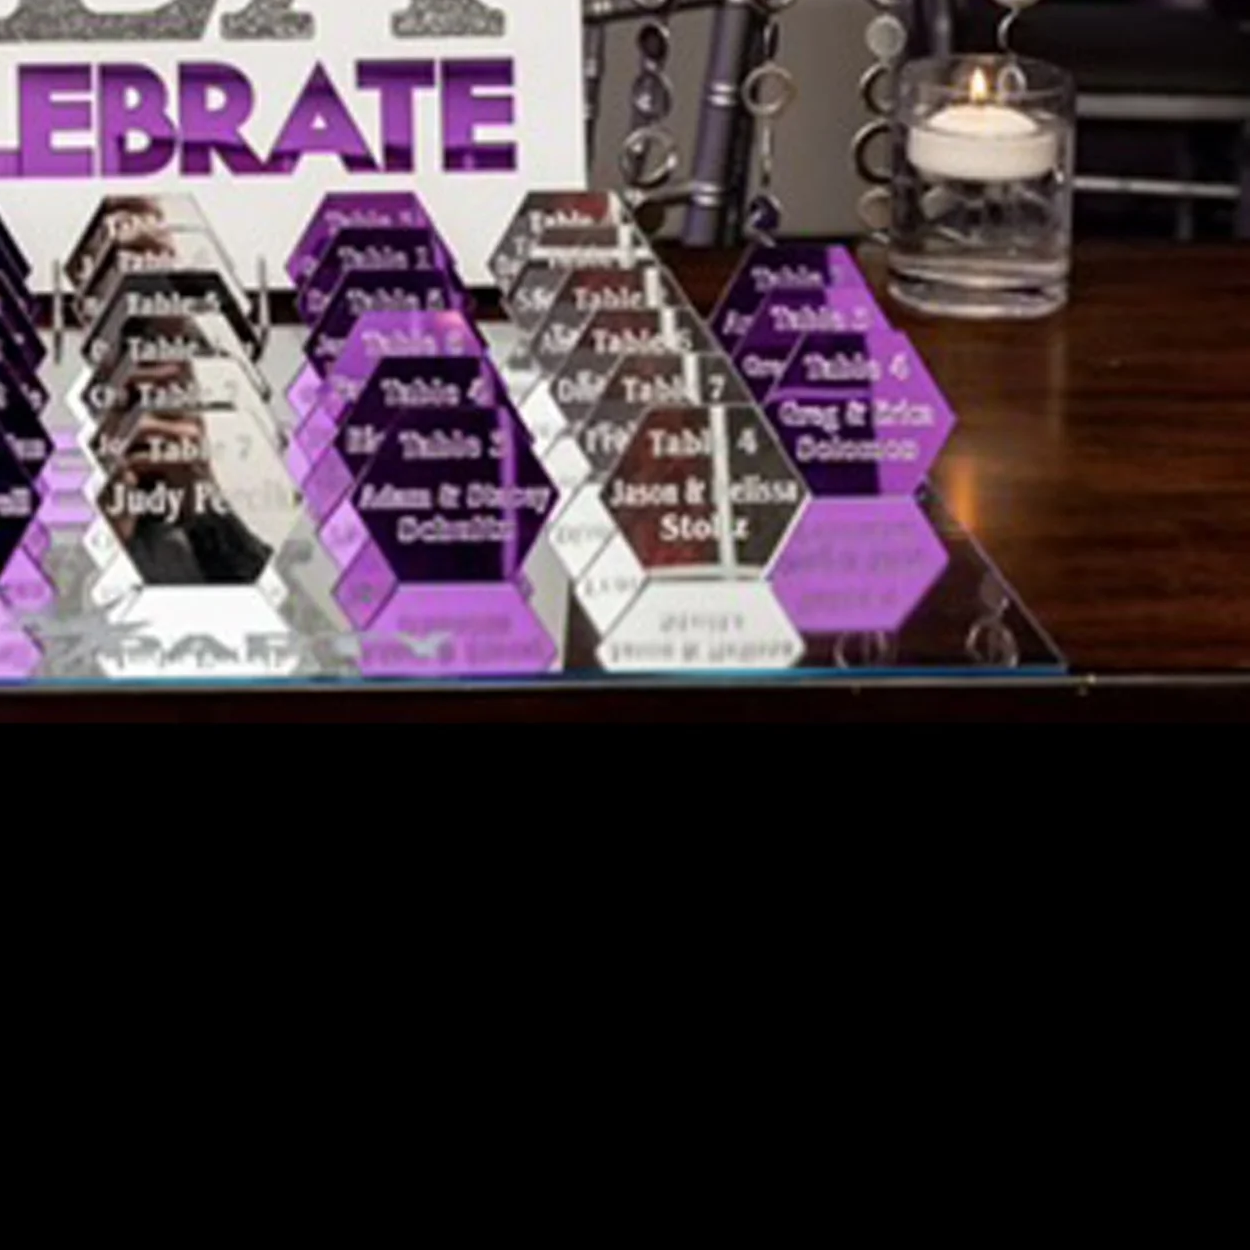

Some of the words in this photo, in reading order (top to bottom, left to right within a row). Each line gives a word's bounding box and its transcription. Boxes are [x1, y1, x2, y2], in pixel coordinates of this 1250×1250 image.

[380, 378, 460, 407] Table
[709, 374, 727, 400] 7
[845, 401, 866, 427] &
[399, 429, 481, 459] Table
[649, 427, 713, 457] Tabl
[737, 427, 758, 455] 4
[106, 480, 184, 525] Judy
[438, 483, 460, 510] &
[610, 478, 680, 507] Jason
[684, 477, 706, 504] &
